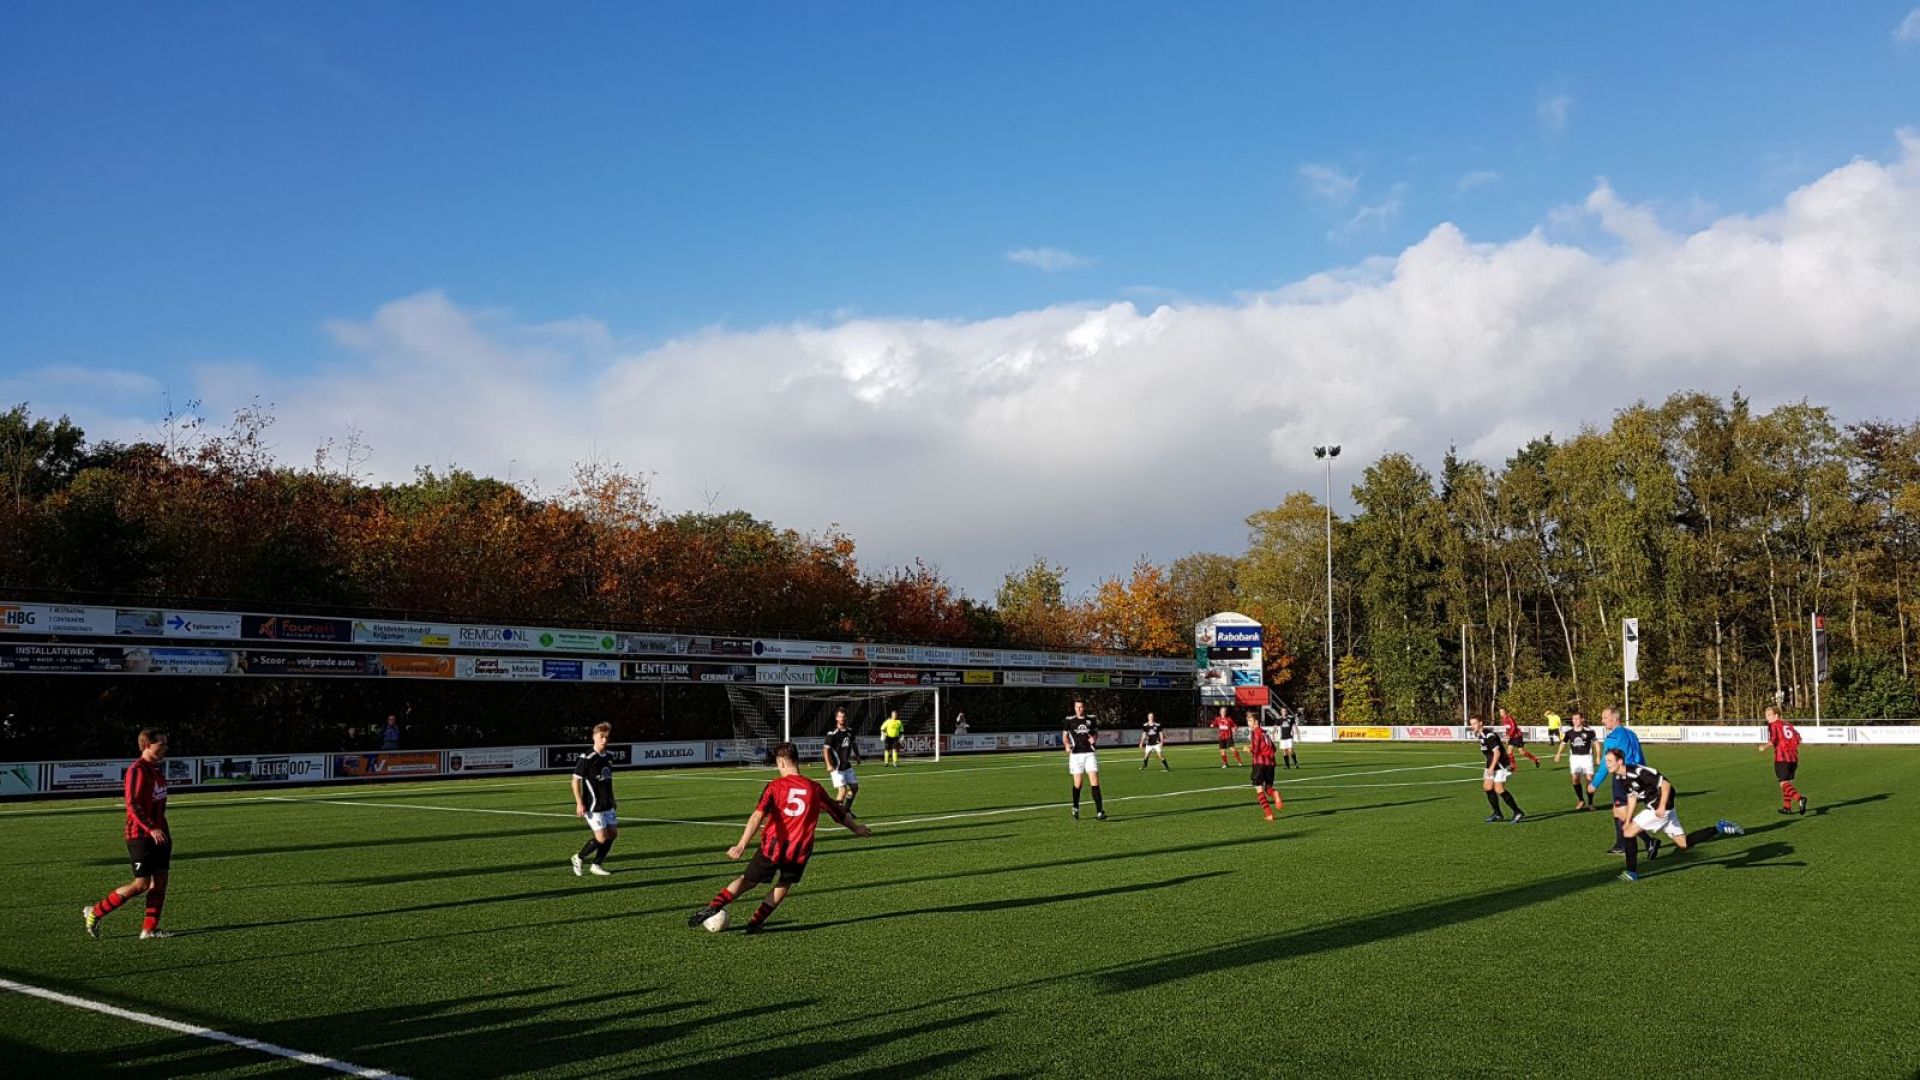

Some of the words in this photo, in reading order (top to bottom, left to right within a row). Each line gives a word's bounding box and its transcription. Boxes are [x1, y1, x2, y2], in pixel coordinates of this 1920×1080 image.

[7, 612, 36, 625] HBG
[1217, 632, 1260, 642] Rabobank
[16, 646, 95, 656] INSTALLATIEWERK
[260, 656, 287, 665] Scoor
[297, 657, 336, 667] volgende
[635, 663, 689, 674] LENTELINK
[1783, 725, 1793, 739] 6
[645, 749, 694, 759] MARKELO
[783, 788, 807, 817] 5
[134, 862, 142, 871] 7
